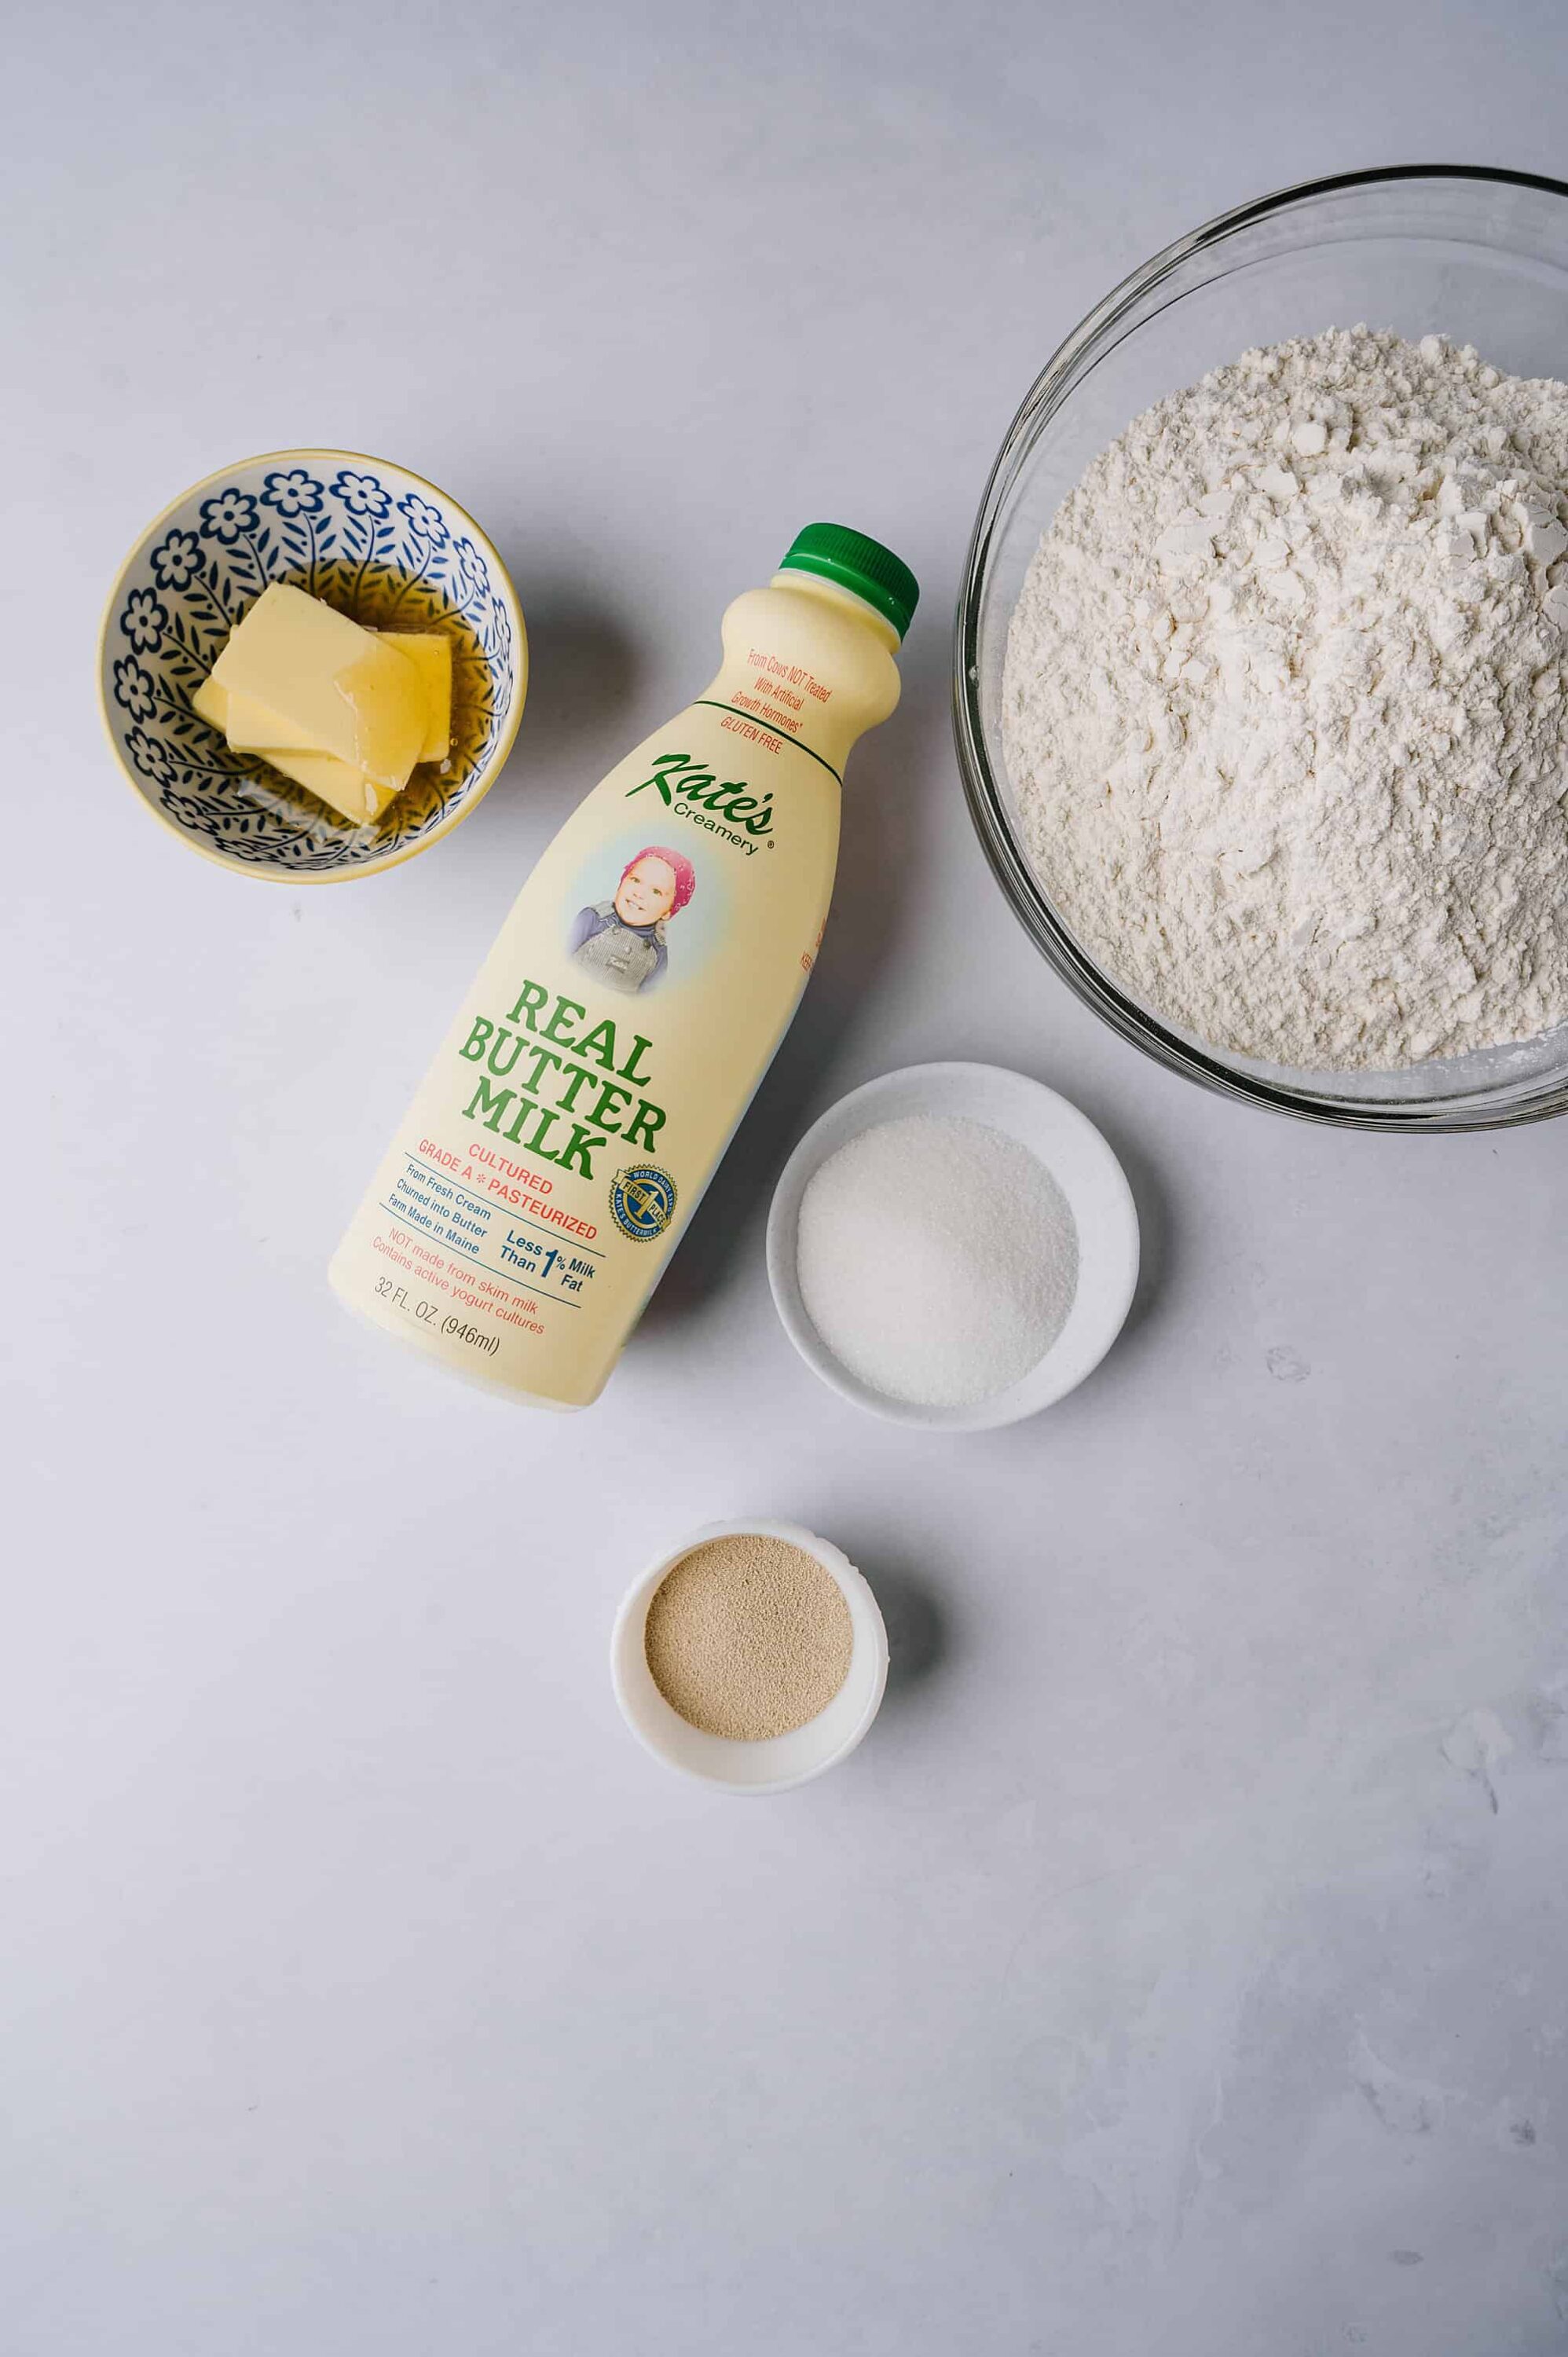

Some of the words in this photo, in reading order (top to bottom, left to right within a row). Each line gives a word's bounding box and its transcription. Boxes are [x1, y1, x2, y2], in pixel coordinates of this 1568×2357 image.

[731, 691, 761, 712] Growth
[747, 648, 768, 668] From
[767, 656, 789, 679] Cows
[788, 666, 808, 685] NOT
[804, 675, 833, 704] Treated
[753, 676, 773, 696] With
[771, 684, 804, 711] Artificial
[720, 717, 759, 742] GLUTEN
[757, 732, 783, 755] FREE
[625, 753, 774, 835] Kate's
[673, 802, 759, 856] Creamery
[506, 979, 653, 1087] REAL
[459, 1016, 667, 1153] BUTTER
[461, 1076, 607, 1180] MILK
[406, 1163, 427, 1184] From
[426, 1178, 455, 1200] Fresh
[455, 1193, 492, 1220] Cream
[419, 1138, 461, 1172] GRADE
[461, 1166, 472, 1180] A
[487, 1178, 598, 1241] PASTEURIZED
[469, 1143, 553, 1196] CULTURED
[622, 1181, 647, 1202] FIRST
[633, 1171, 658, 1180] WORLD
[388, 1193, 408, 1212] Farm
[407, 1206, 433, 1228] Made
[433, 1222, 445, 1236] in
[445, 1229, 480, 1255] Maine
[397, 1178, 432, 1207] Churned
[431, 1199, 451, 1218] into
[451, 1211, 488, 1238] Butter
[388, 1226, 413, 1249] NOT
[412, 1243, 445, 1269] made
[446, 1263, 476, 1286] from
[478, 1279, 510, 1302] skim
[511, 1296, 539, 1314] milk
[500, 1245, 537, 1273] Than
[560, 1274, 584, 1292] Fat
[506, 1230, 544, 1256] Less
[568, 1258, 596, 1279] Milk
[372, 1236, 412, 1271] Contains
[413, 1264, 450, 1291] active
[450, 1285, 495, 1314] yogurt
[495, 1306, 546, 1335] cultures
[375, 1277, 393, 1298] 32
[392, 1286, 410, 1312] FL.
[415, 1300, 439, 1326] OZ.
[440, 1314, 500, 1357] (946ml)
